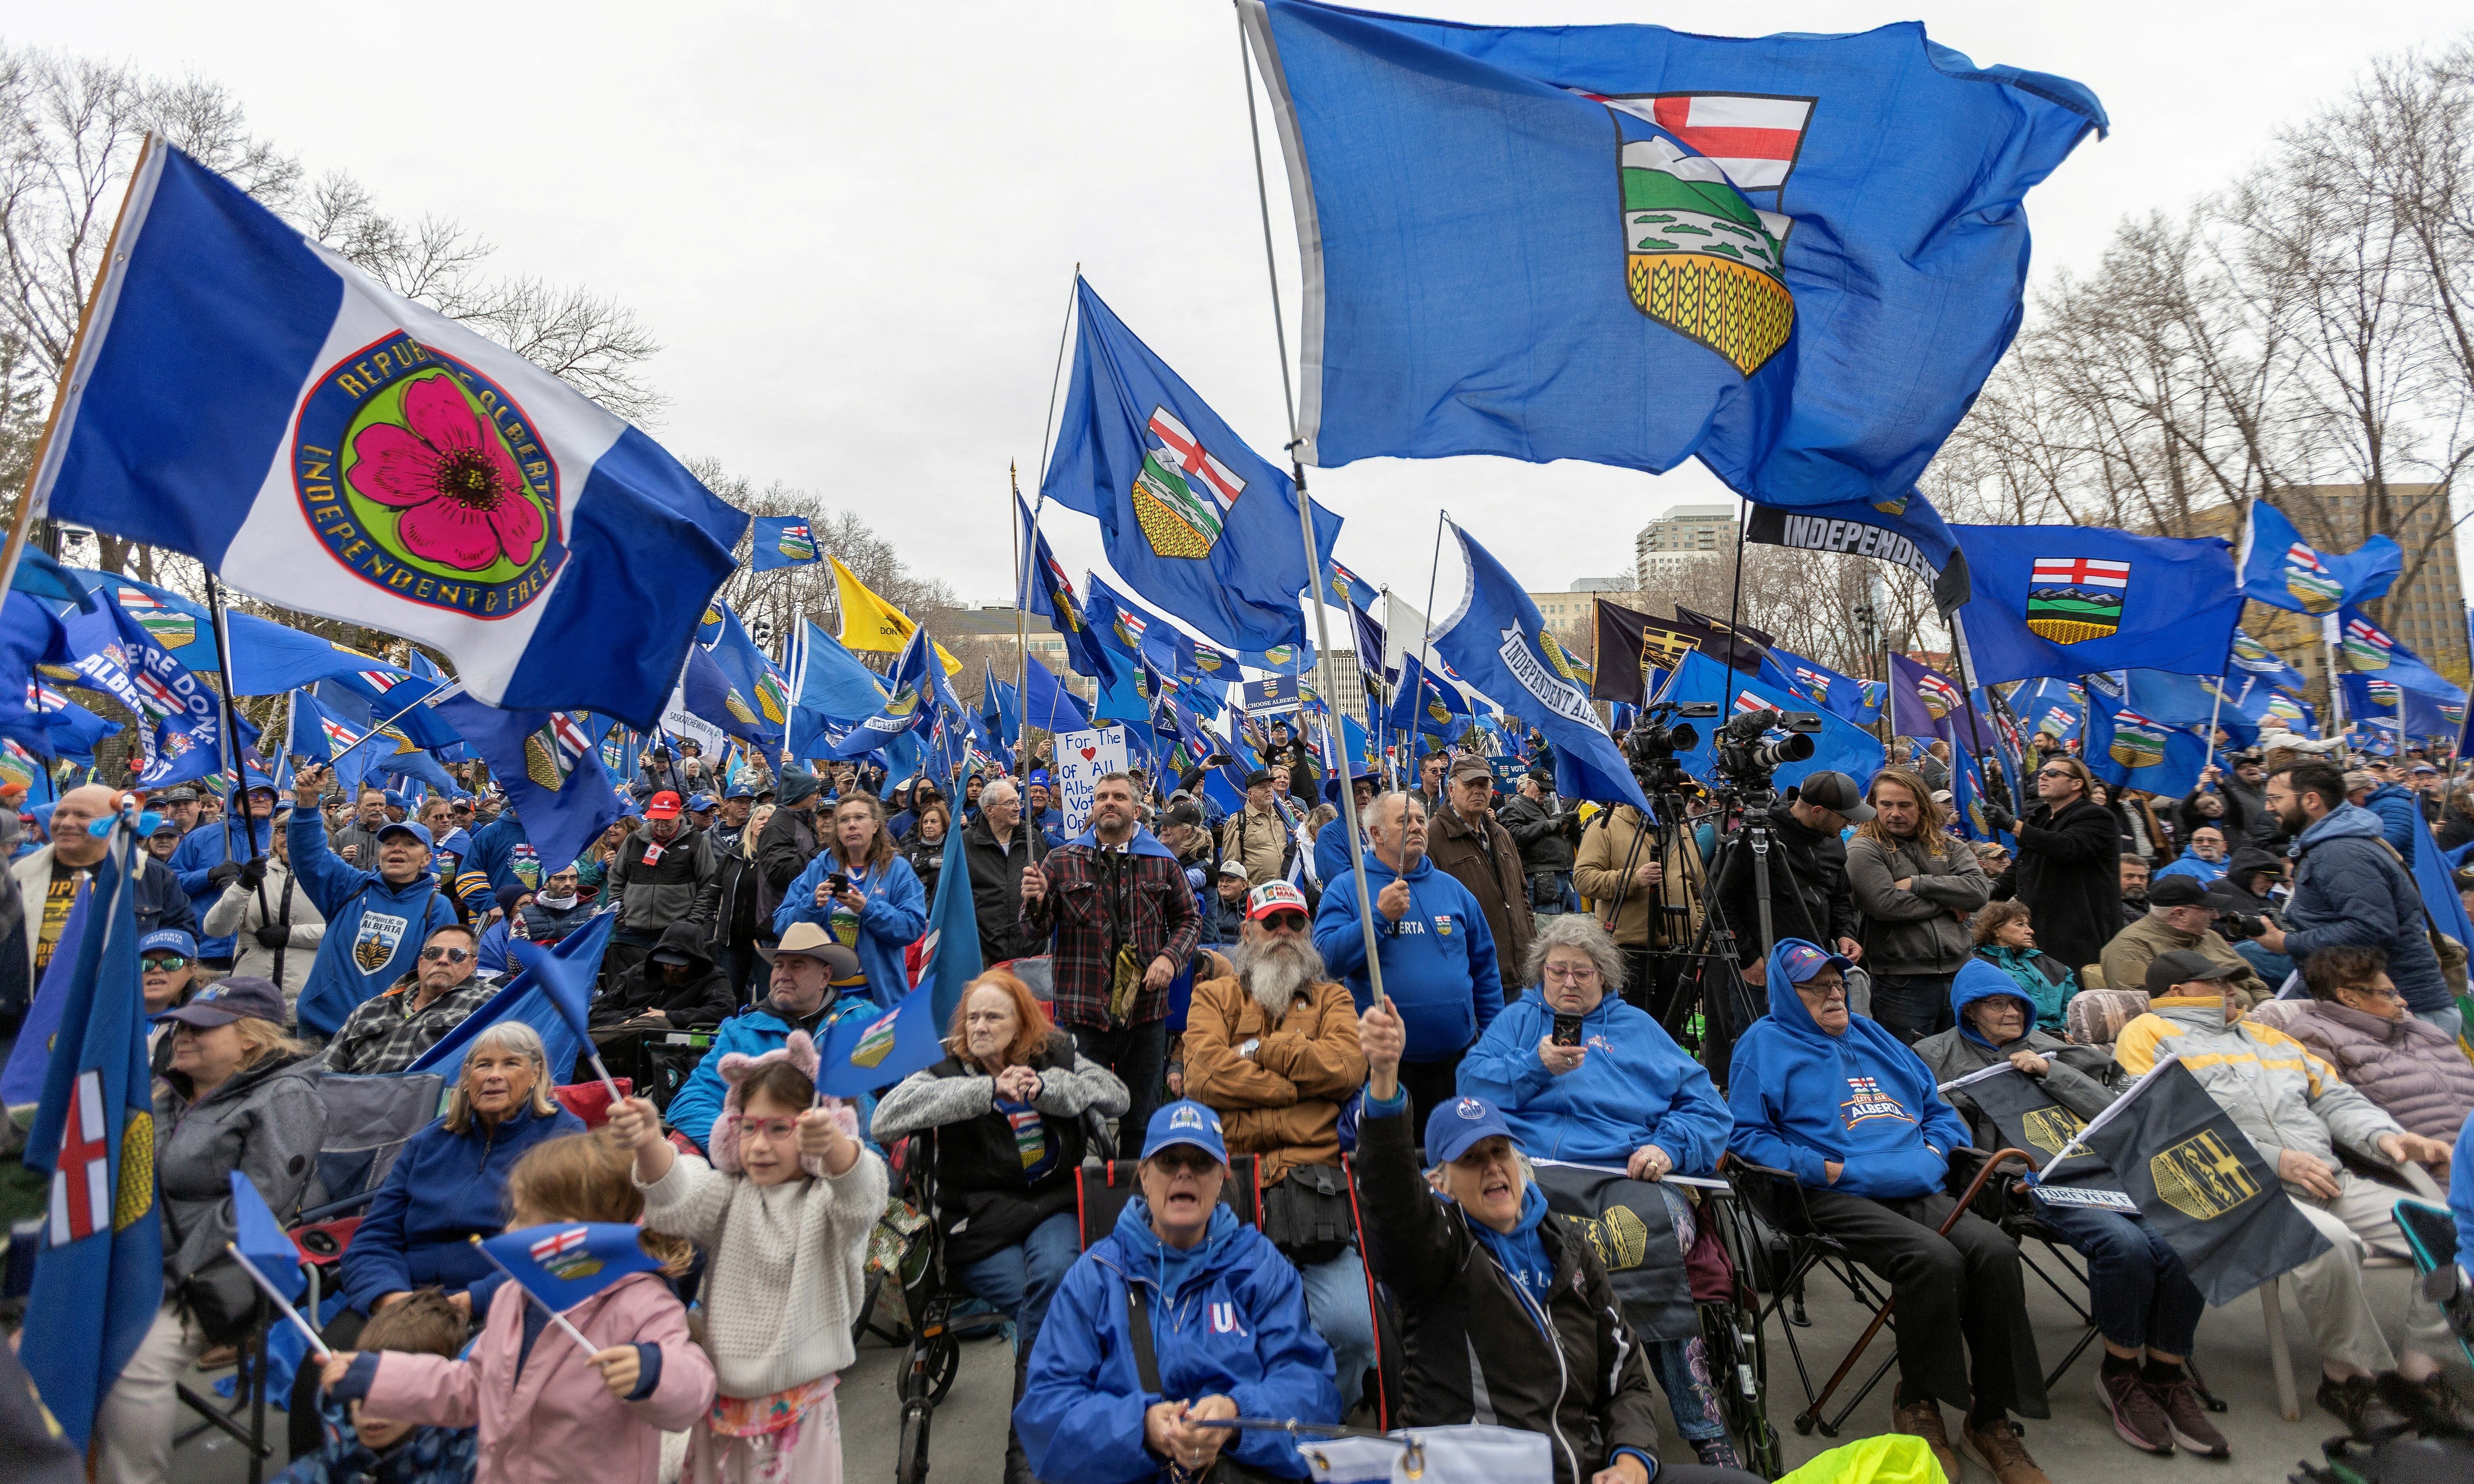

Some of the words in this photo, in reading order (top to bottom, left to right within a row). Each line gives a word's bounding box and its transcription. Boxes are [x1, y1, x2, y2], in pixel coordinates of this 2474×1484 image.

[302, 444, 480, 607] INDEPENDENT
[507, 559, 552, 610] FREE
[1783, 514, 1940, 593] INDEPENDENT
[1505, 641, 1574, 711] INDEPENDENT
[121, 639, 178, 679] E'RE
[172, 673, 217, 745] DONE
[1272, 696, 1298, 705] ALBERTA
[669, 712, 708, 733] SASKATCHEWAN
[1065, 734, 1090, 750] For
[1097, 729, 1121, 746] The
[1062, 764, 1077, 779] Of
[1092, 760, 1114, 776] All
[1064, 782, 1094, 796] Albe
[1069, 794, 1094, 811] Vot
[364, 913, 395, 925] REPUBLIC
[361, 920, 402, 935] ALBERTA
[146, 936, 184, 945] REPUBLIC
[1852, 1102, 1905, 1118] ALBERTA
[1170, 1122, 1190, 1130] ALBERTA
[1191, 1122, 1204, 1131] FIRST
[2038, 1189, 2116, 1203] FOREVER
